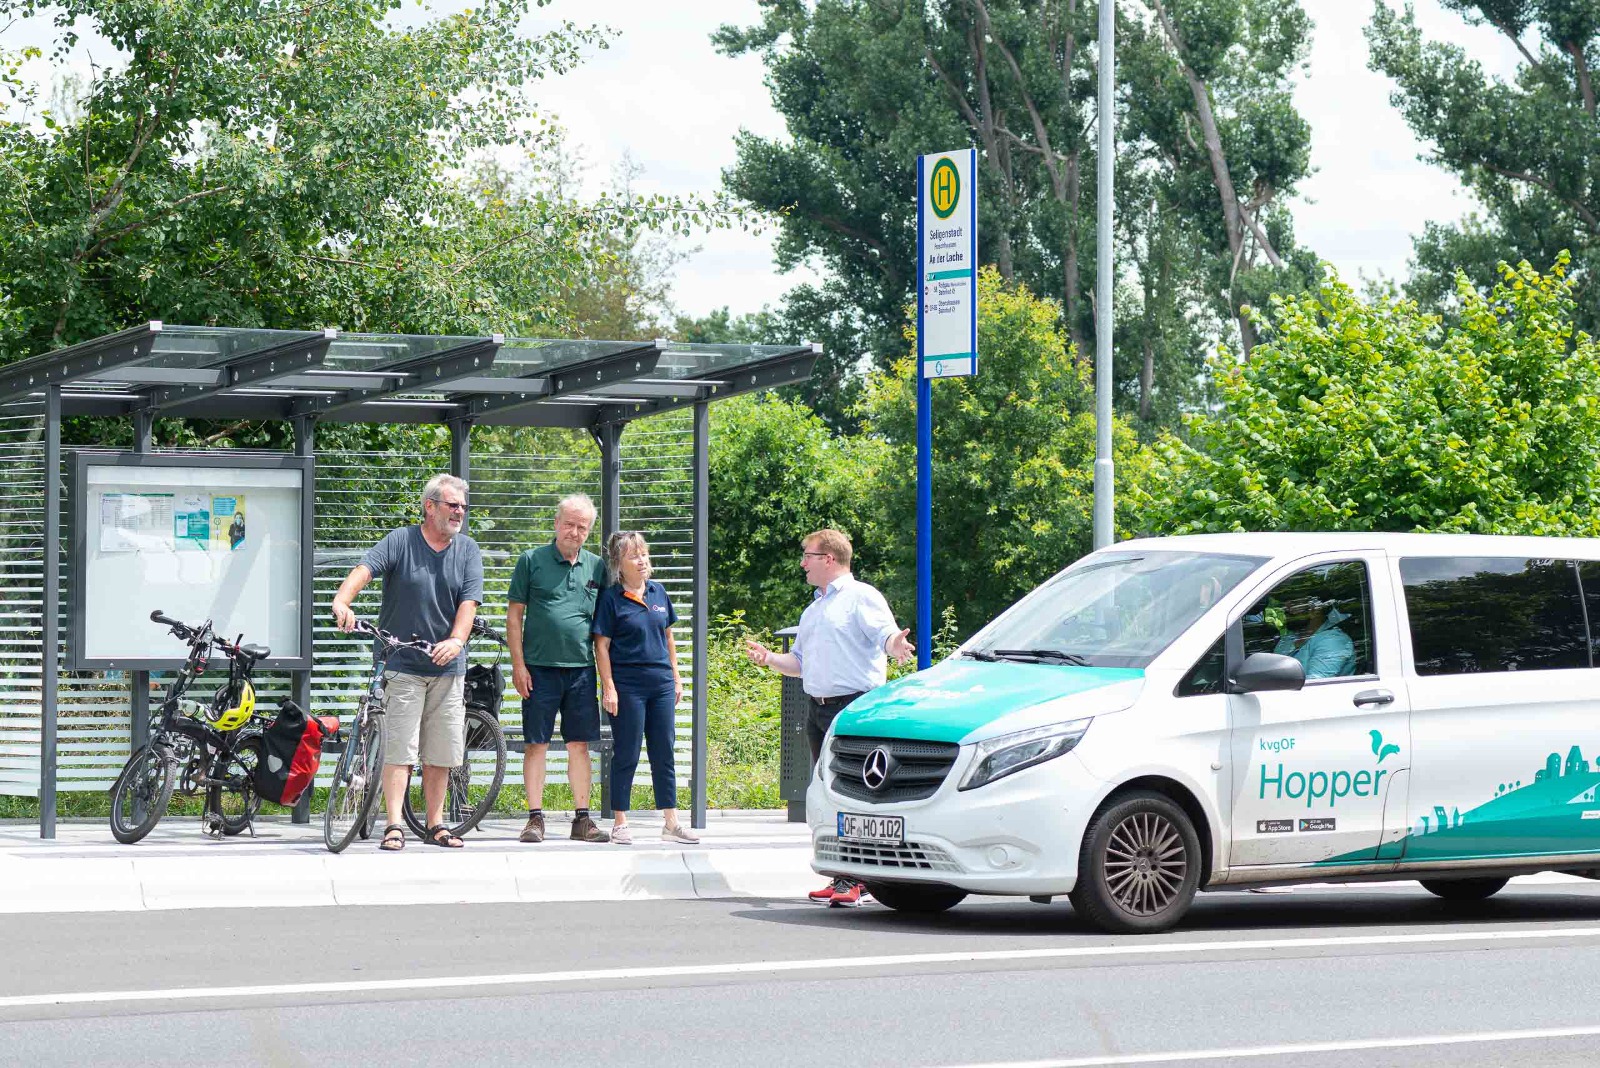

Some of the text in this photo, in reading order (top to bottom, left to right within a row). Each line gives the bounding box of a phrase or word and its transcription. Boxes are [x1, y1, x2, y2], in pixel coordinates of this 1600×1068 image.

[938, 170, 951, 206] H
[929, 226, 963, 241] Seligenstadt
[929, 251, 963, 264] An der Lache
[1260, 738, 1295, 753] kvgOF
[1259, 763, 1387, 808] Hopper
[844, 816, 901, 838] OF HO 102
[1309, 823, 1325, 831] Google
